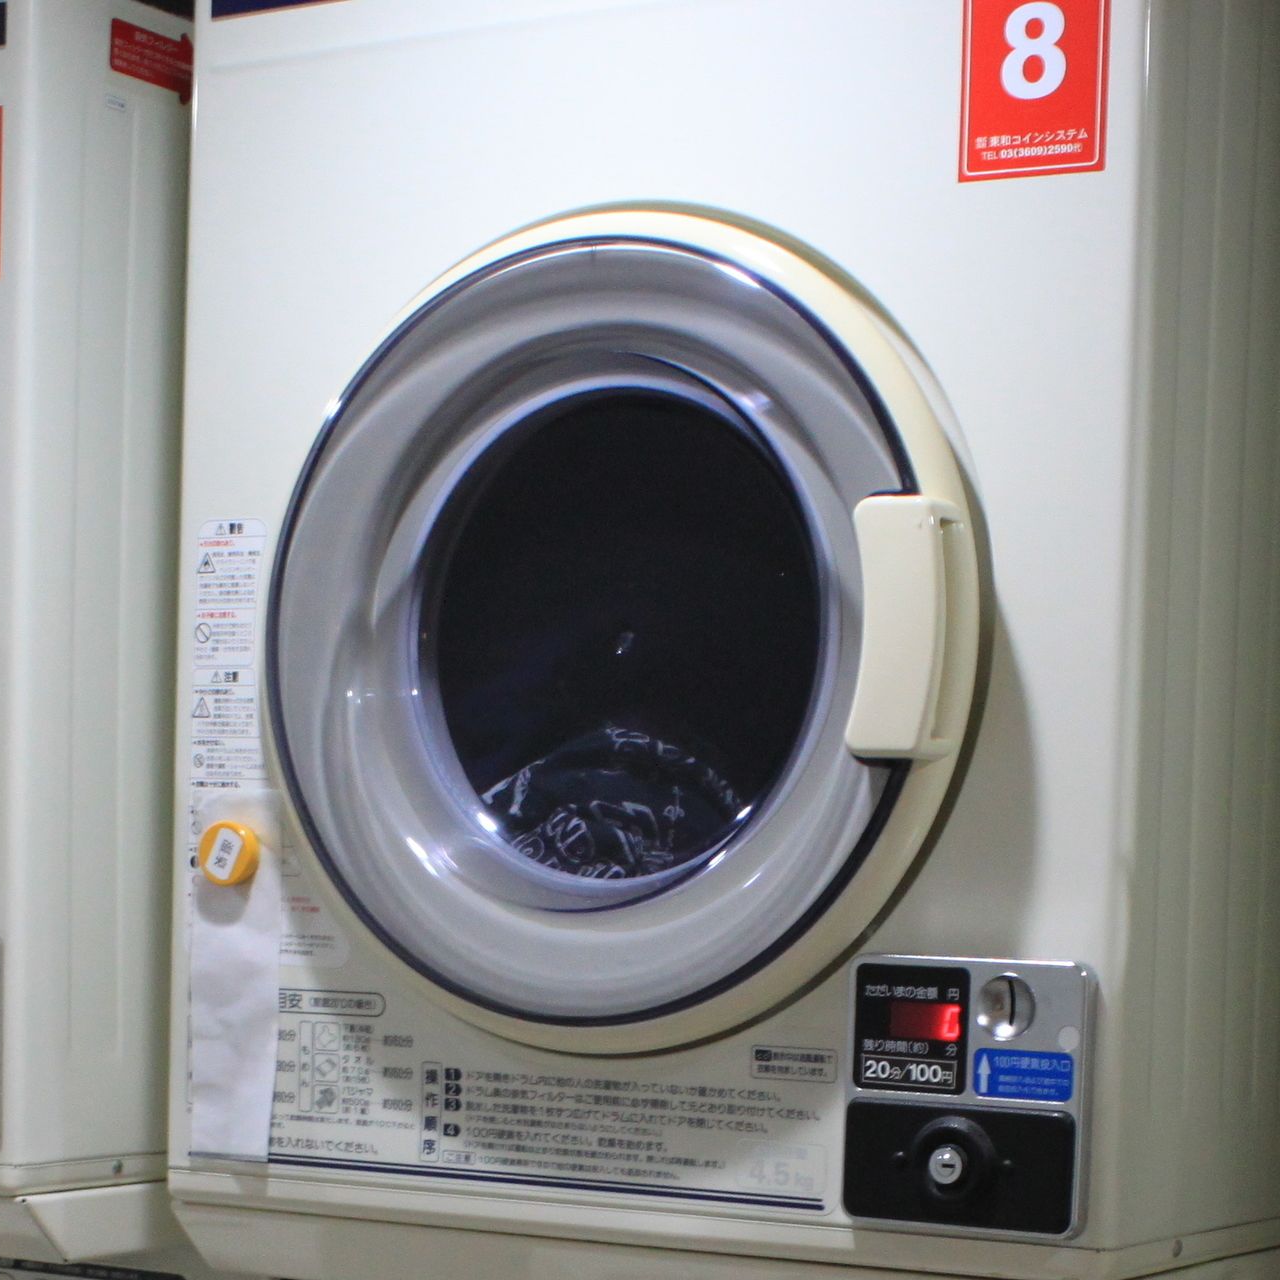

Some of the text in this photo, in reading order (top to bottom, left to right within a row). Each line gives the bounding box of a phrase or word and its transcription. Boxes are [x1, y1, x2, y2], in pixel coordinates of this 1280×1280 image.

[1000, 1, 1067, 101] 8
[947, 988, 960, 1001] 円
[945, 1043, 958, 1057] 分
[864, 1060, 954, 1084] 20分/100円
